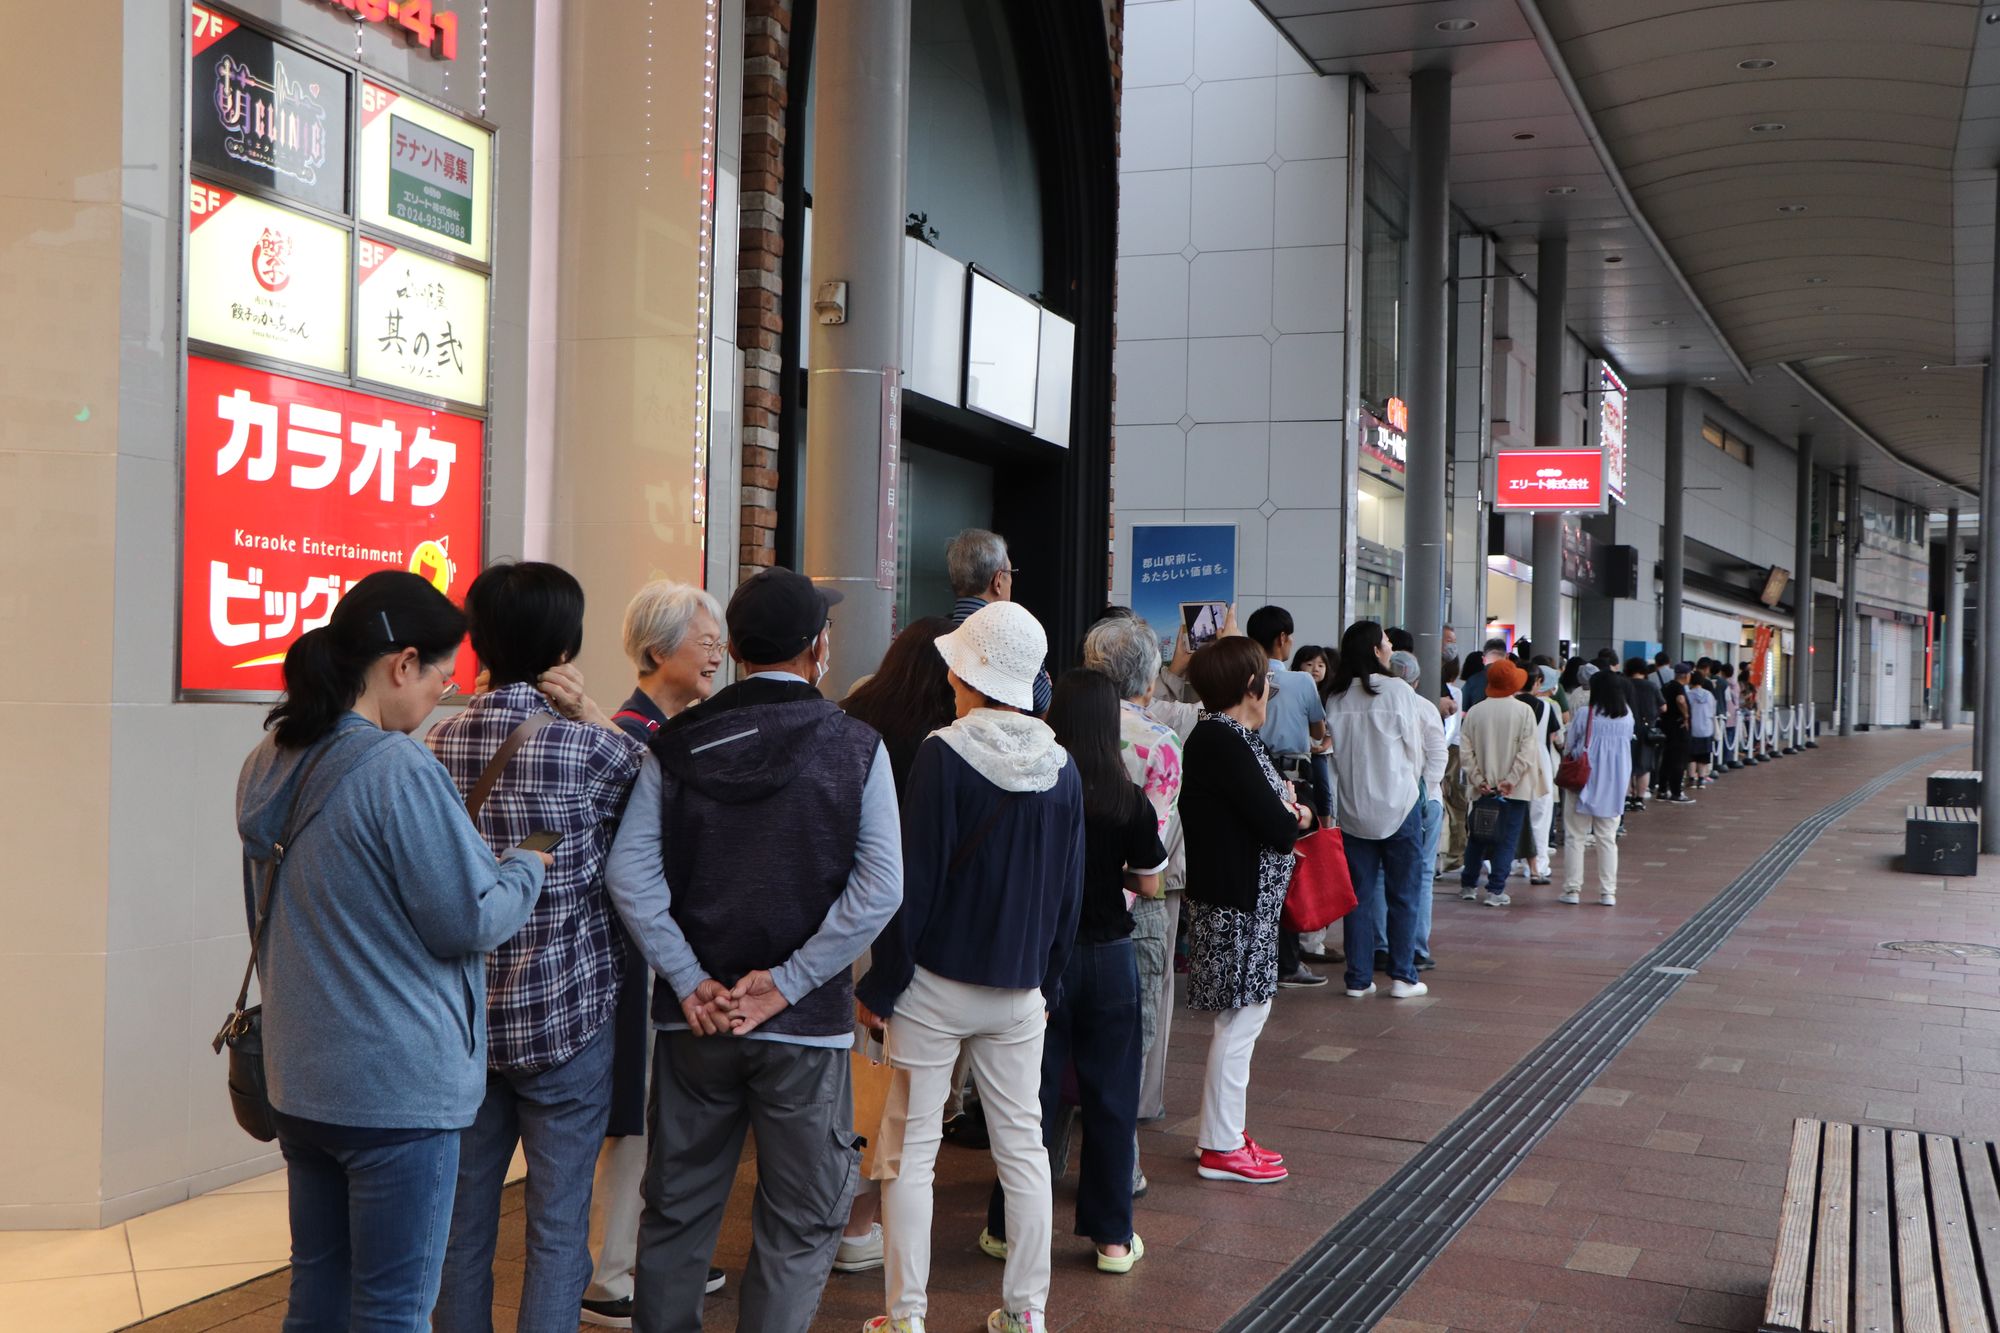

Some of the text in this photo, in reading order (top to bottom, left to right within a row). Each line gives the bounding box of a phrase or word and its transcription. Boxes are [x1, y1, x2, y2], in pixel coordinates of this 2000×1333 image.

[191, 6, 223, 38] 7F
[362, 84, 387, 112] 6F
[396, 133, 468, 184] テナント募集
[190, 184, 220, 215] 5F
[403, 190, 461, 221] エリート株式会社
[406, 206, 466, 239] 024-933-0988
[359, 240, 384, 268] 8F
[216, 388, 457, 507] カラオケ
[1508, 478, 1590, 490] エリート株式会社
[234, 528, 404, 564] Karaoke Entertainment
[1142, 552, 1203, 569] 郡山駅前に、
[1141, 563, 1229, 584] あたらしい価値を。
[209, 560, 358, 647] ビッグ
